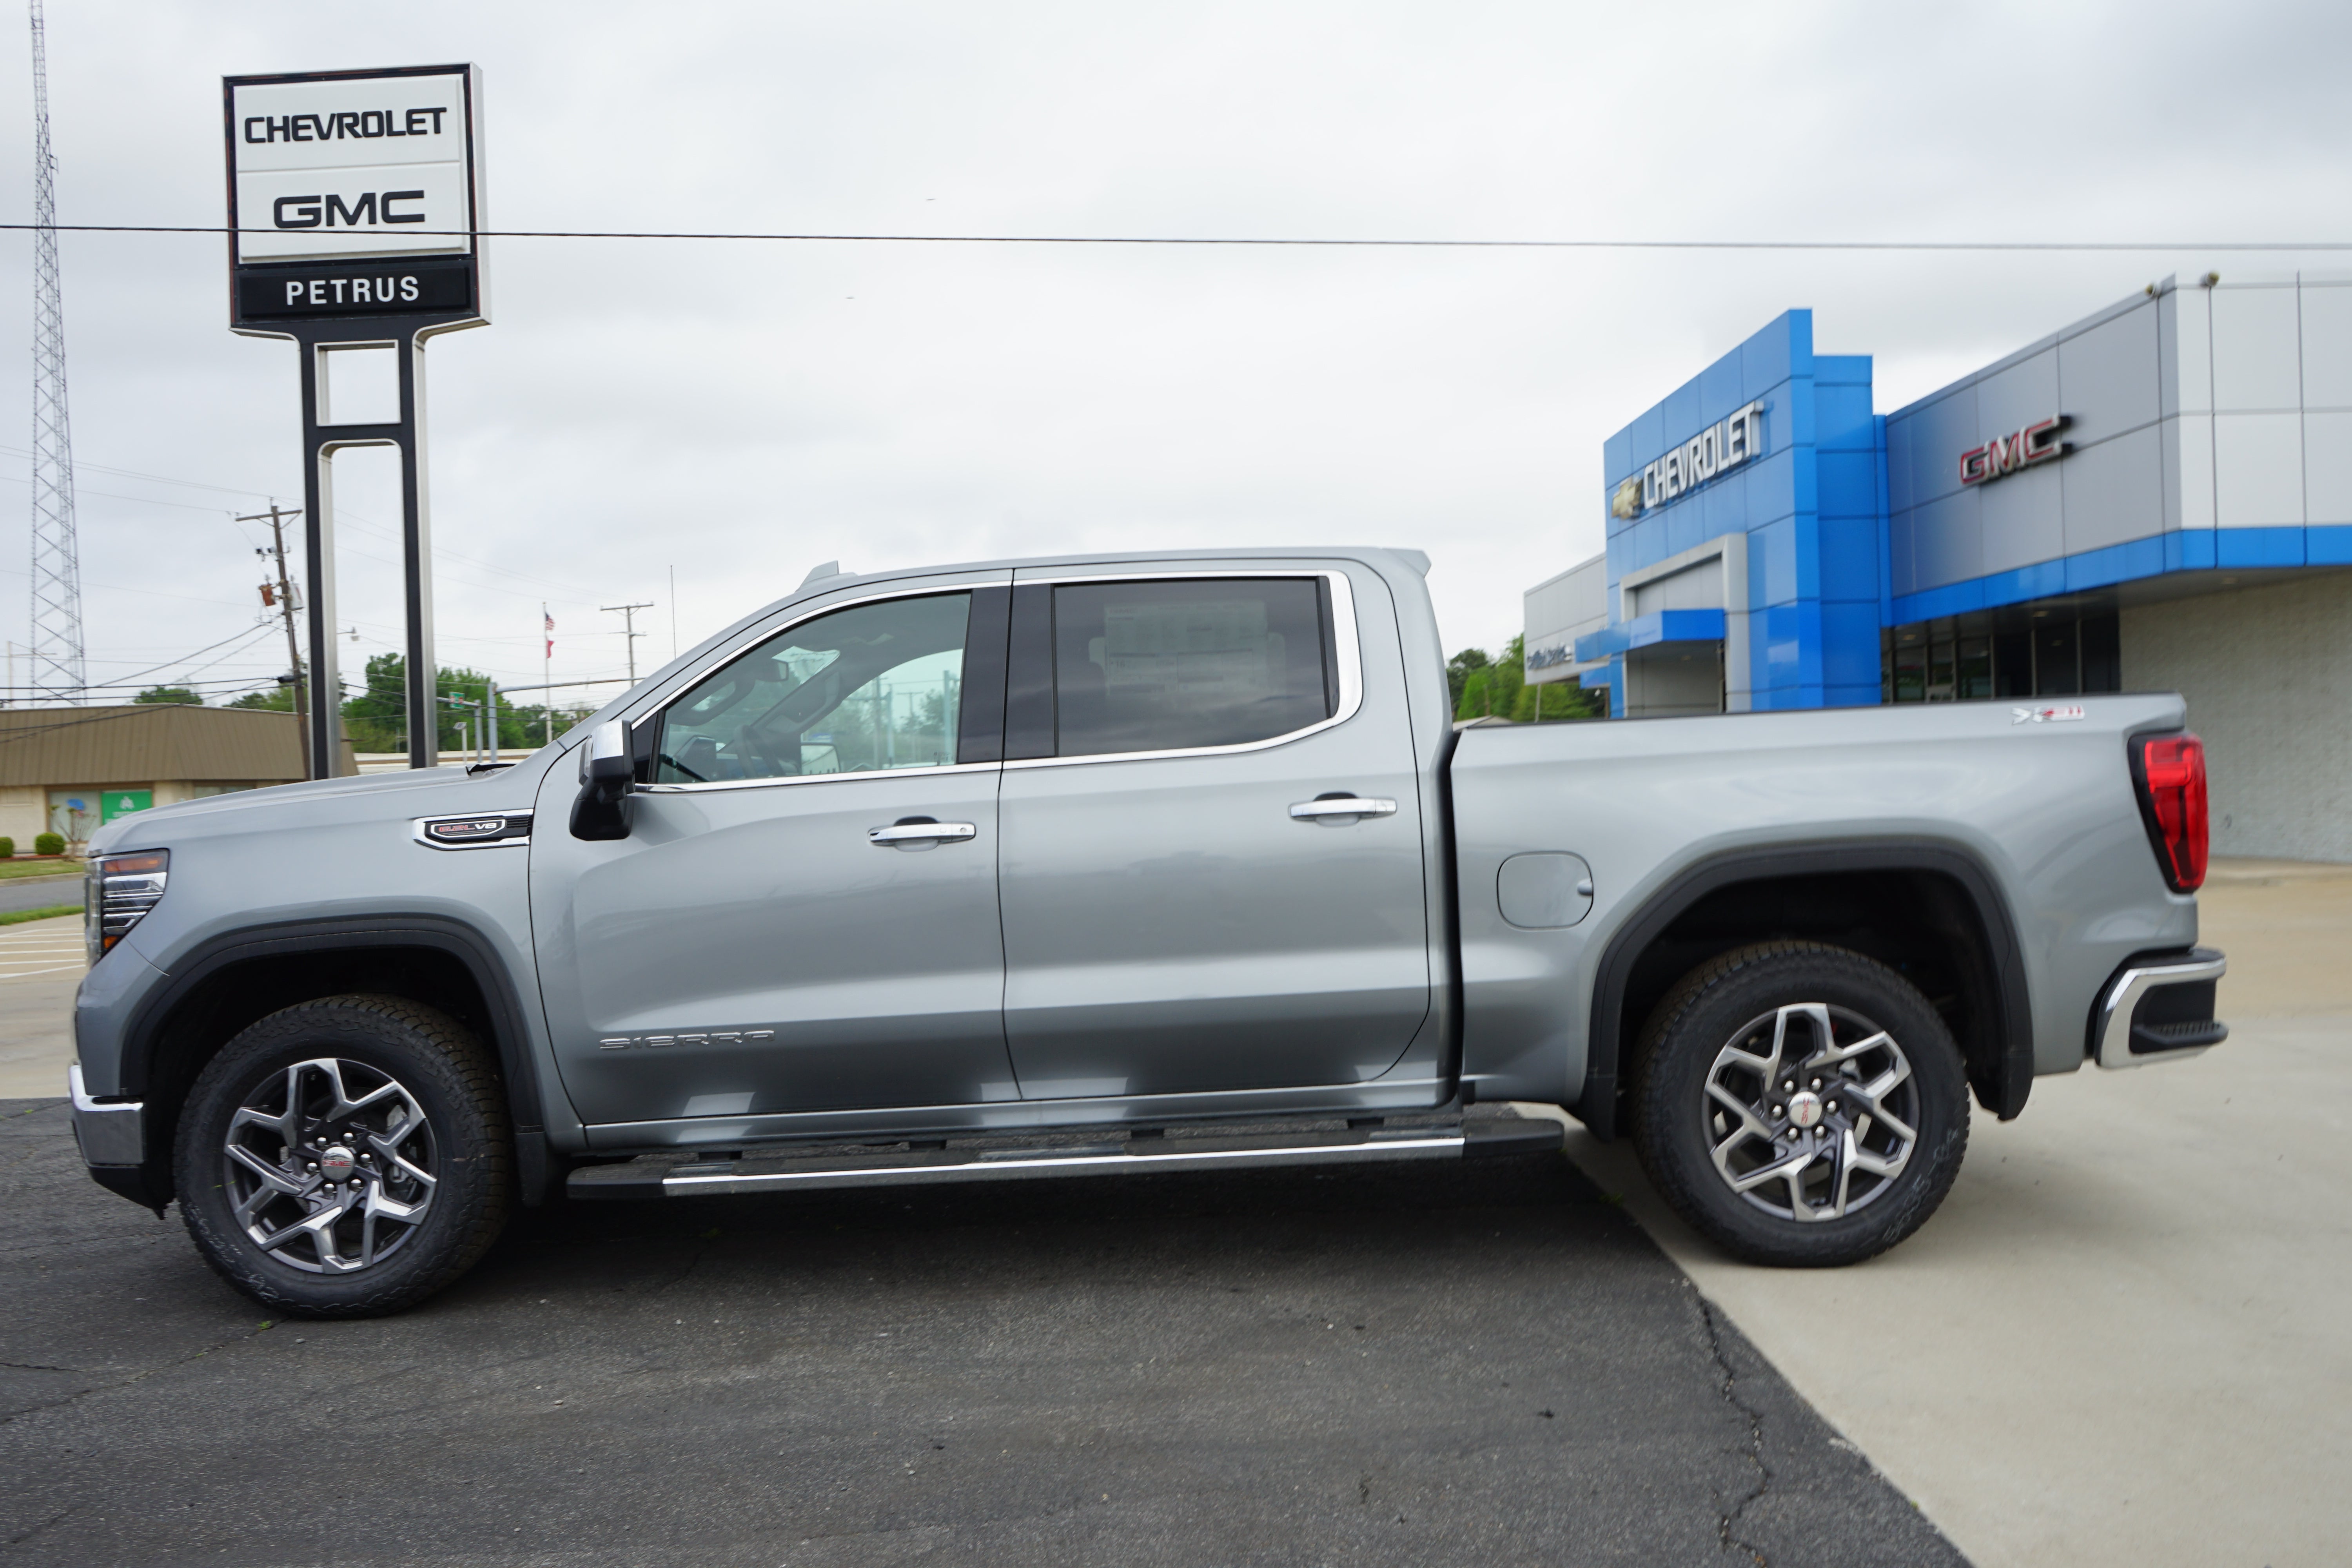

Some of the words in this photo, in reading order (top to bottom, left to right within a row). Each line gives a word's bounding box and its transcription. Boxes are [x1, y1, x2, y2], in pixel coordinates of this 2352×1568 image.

[244, 107, 447, 143] CHEVROLET
[274, 190, 425, 229] GMC
[286, 276, 419, 306] PETRUS
[1643, 399, 1764, 510] CHEVROLET
[1959, 412, 2063, 485] GMC
[599, 1030, 775, 1049] SIERRA
